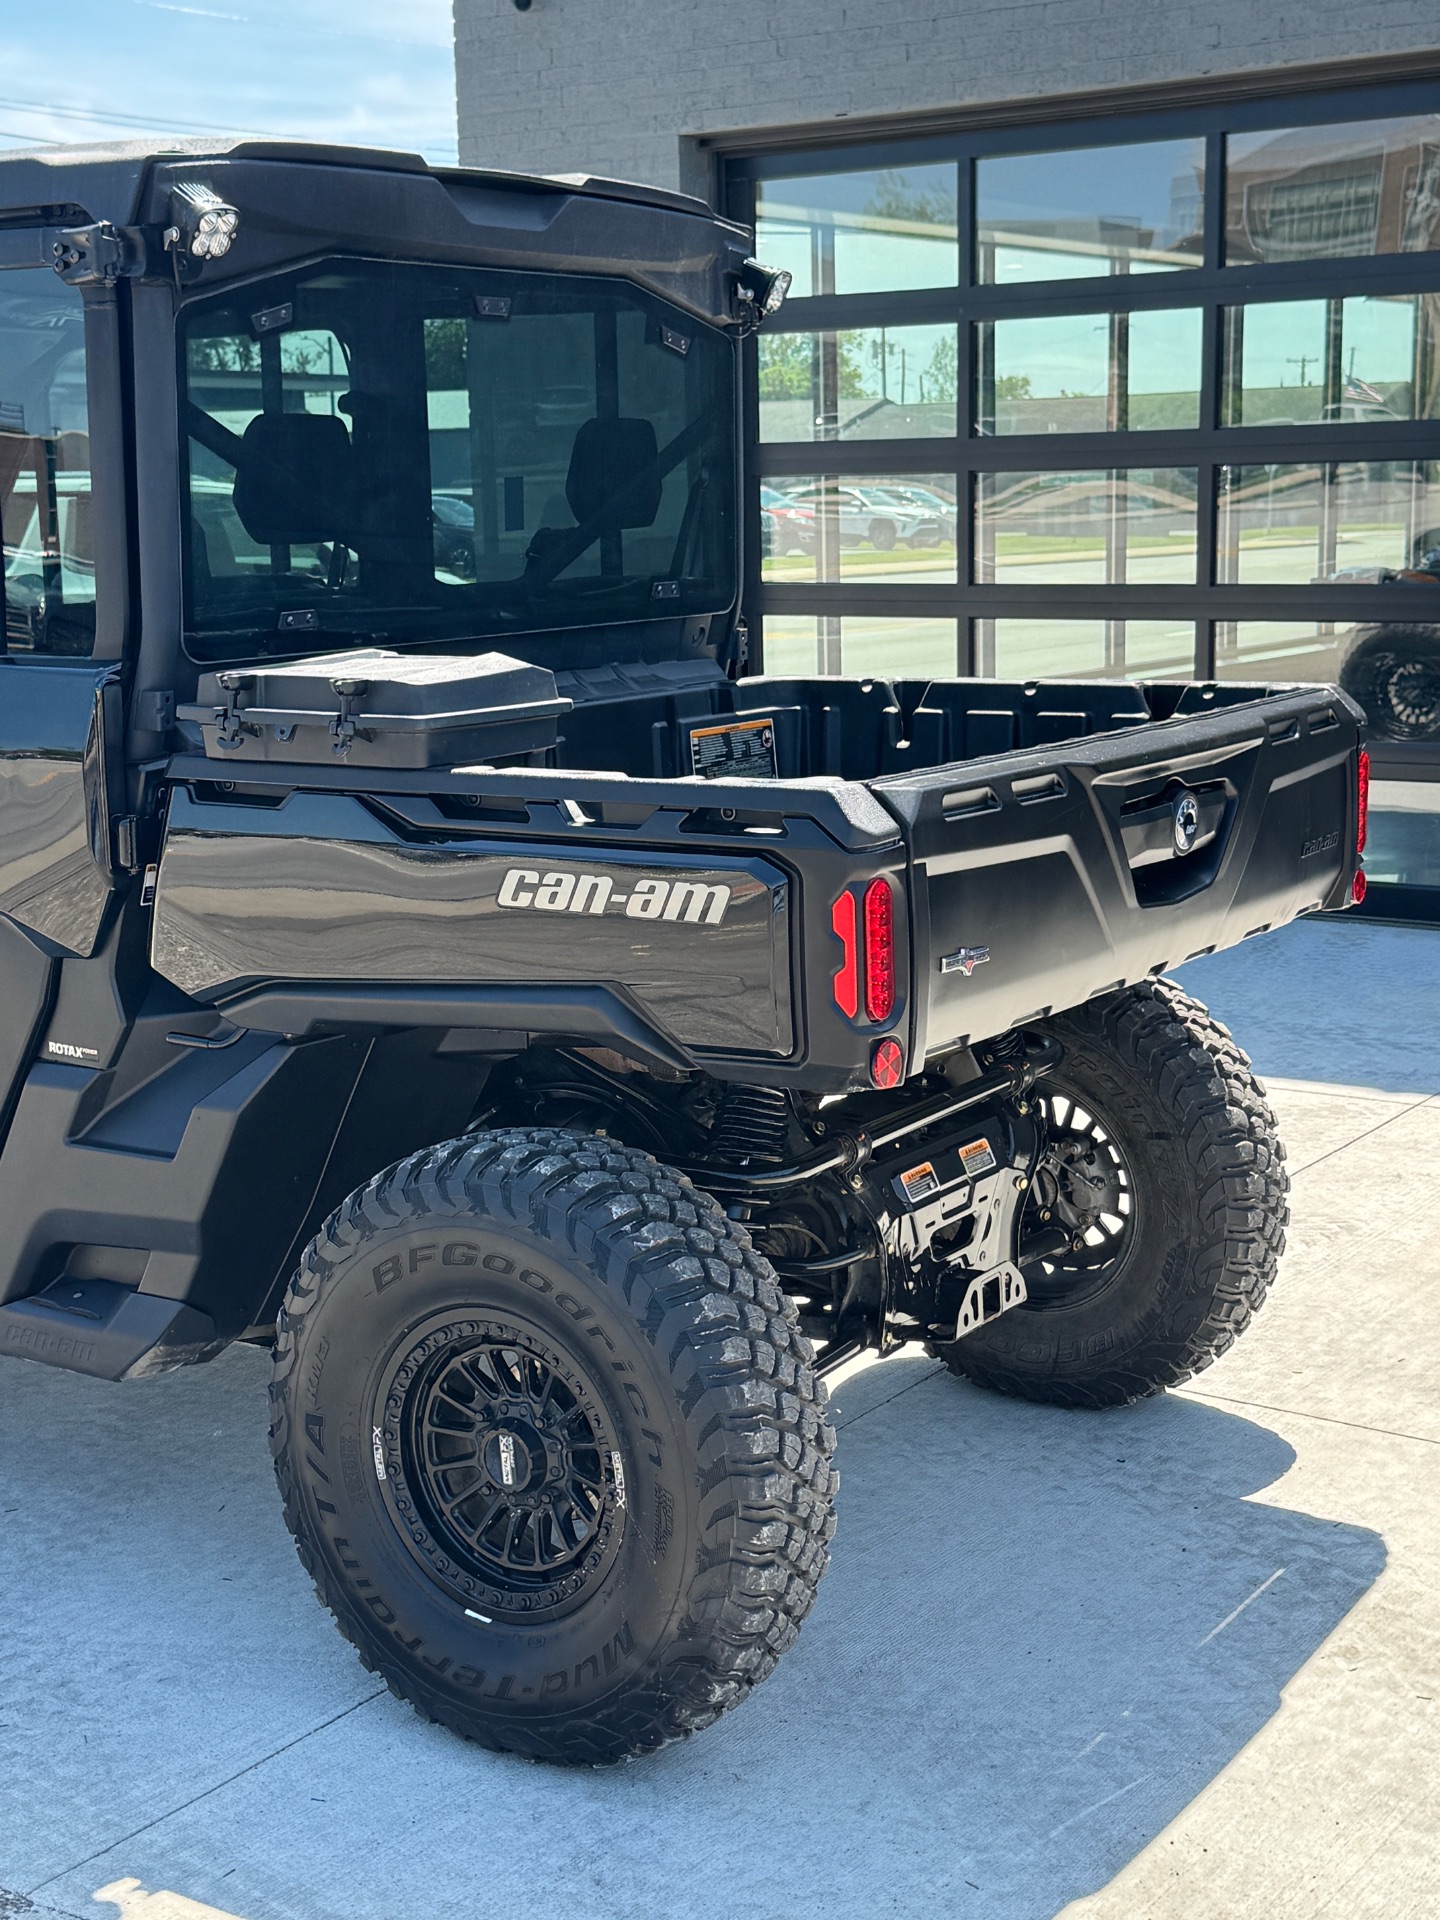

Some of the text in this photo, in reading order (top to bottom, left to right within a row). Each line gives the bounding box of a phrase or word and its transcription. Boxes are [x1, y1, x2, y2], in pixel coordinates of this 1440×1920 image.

[497, 869, 731, 925] can-am
[48, 1041, 83, 1058] ROTAX
[372, 1241, 663, 1469] BFGoodrich
[372, 1424, 382, 1445] FX
[305, 1413, 342, 1522] T/A
[615, 1488, 626, 1510] FX
[336, 1538, 636, 1700] Mud-Terrain
